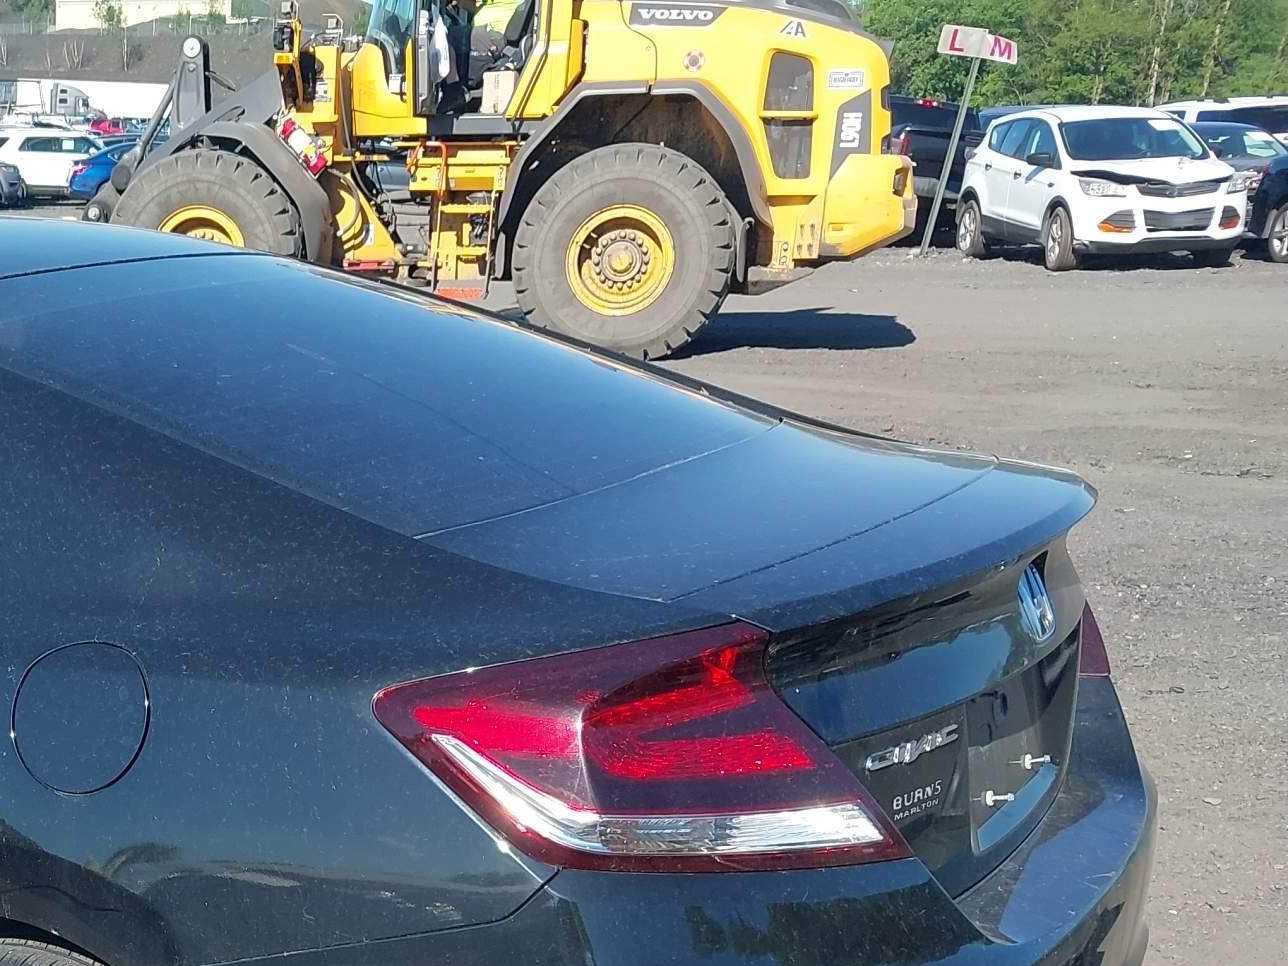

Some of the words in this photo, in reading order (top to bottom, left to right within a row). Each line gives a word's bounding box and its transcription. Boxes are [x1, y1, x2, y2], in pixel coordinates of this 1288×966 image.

[637, 8, 714, 20] VOLVO
[948, 29, 964, 52] L
[990, 37, 1012, 60] M
[839, 112, 863, 148] L90H
[865, 724, 959, 771] CIVIC
[893, 780, 942, 810] BURNS
[894, 799, 939, 820] MARLTON
